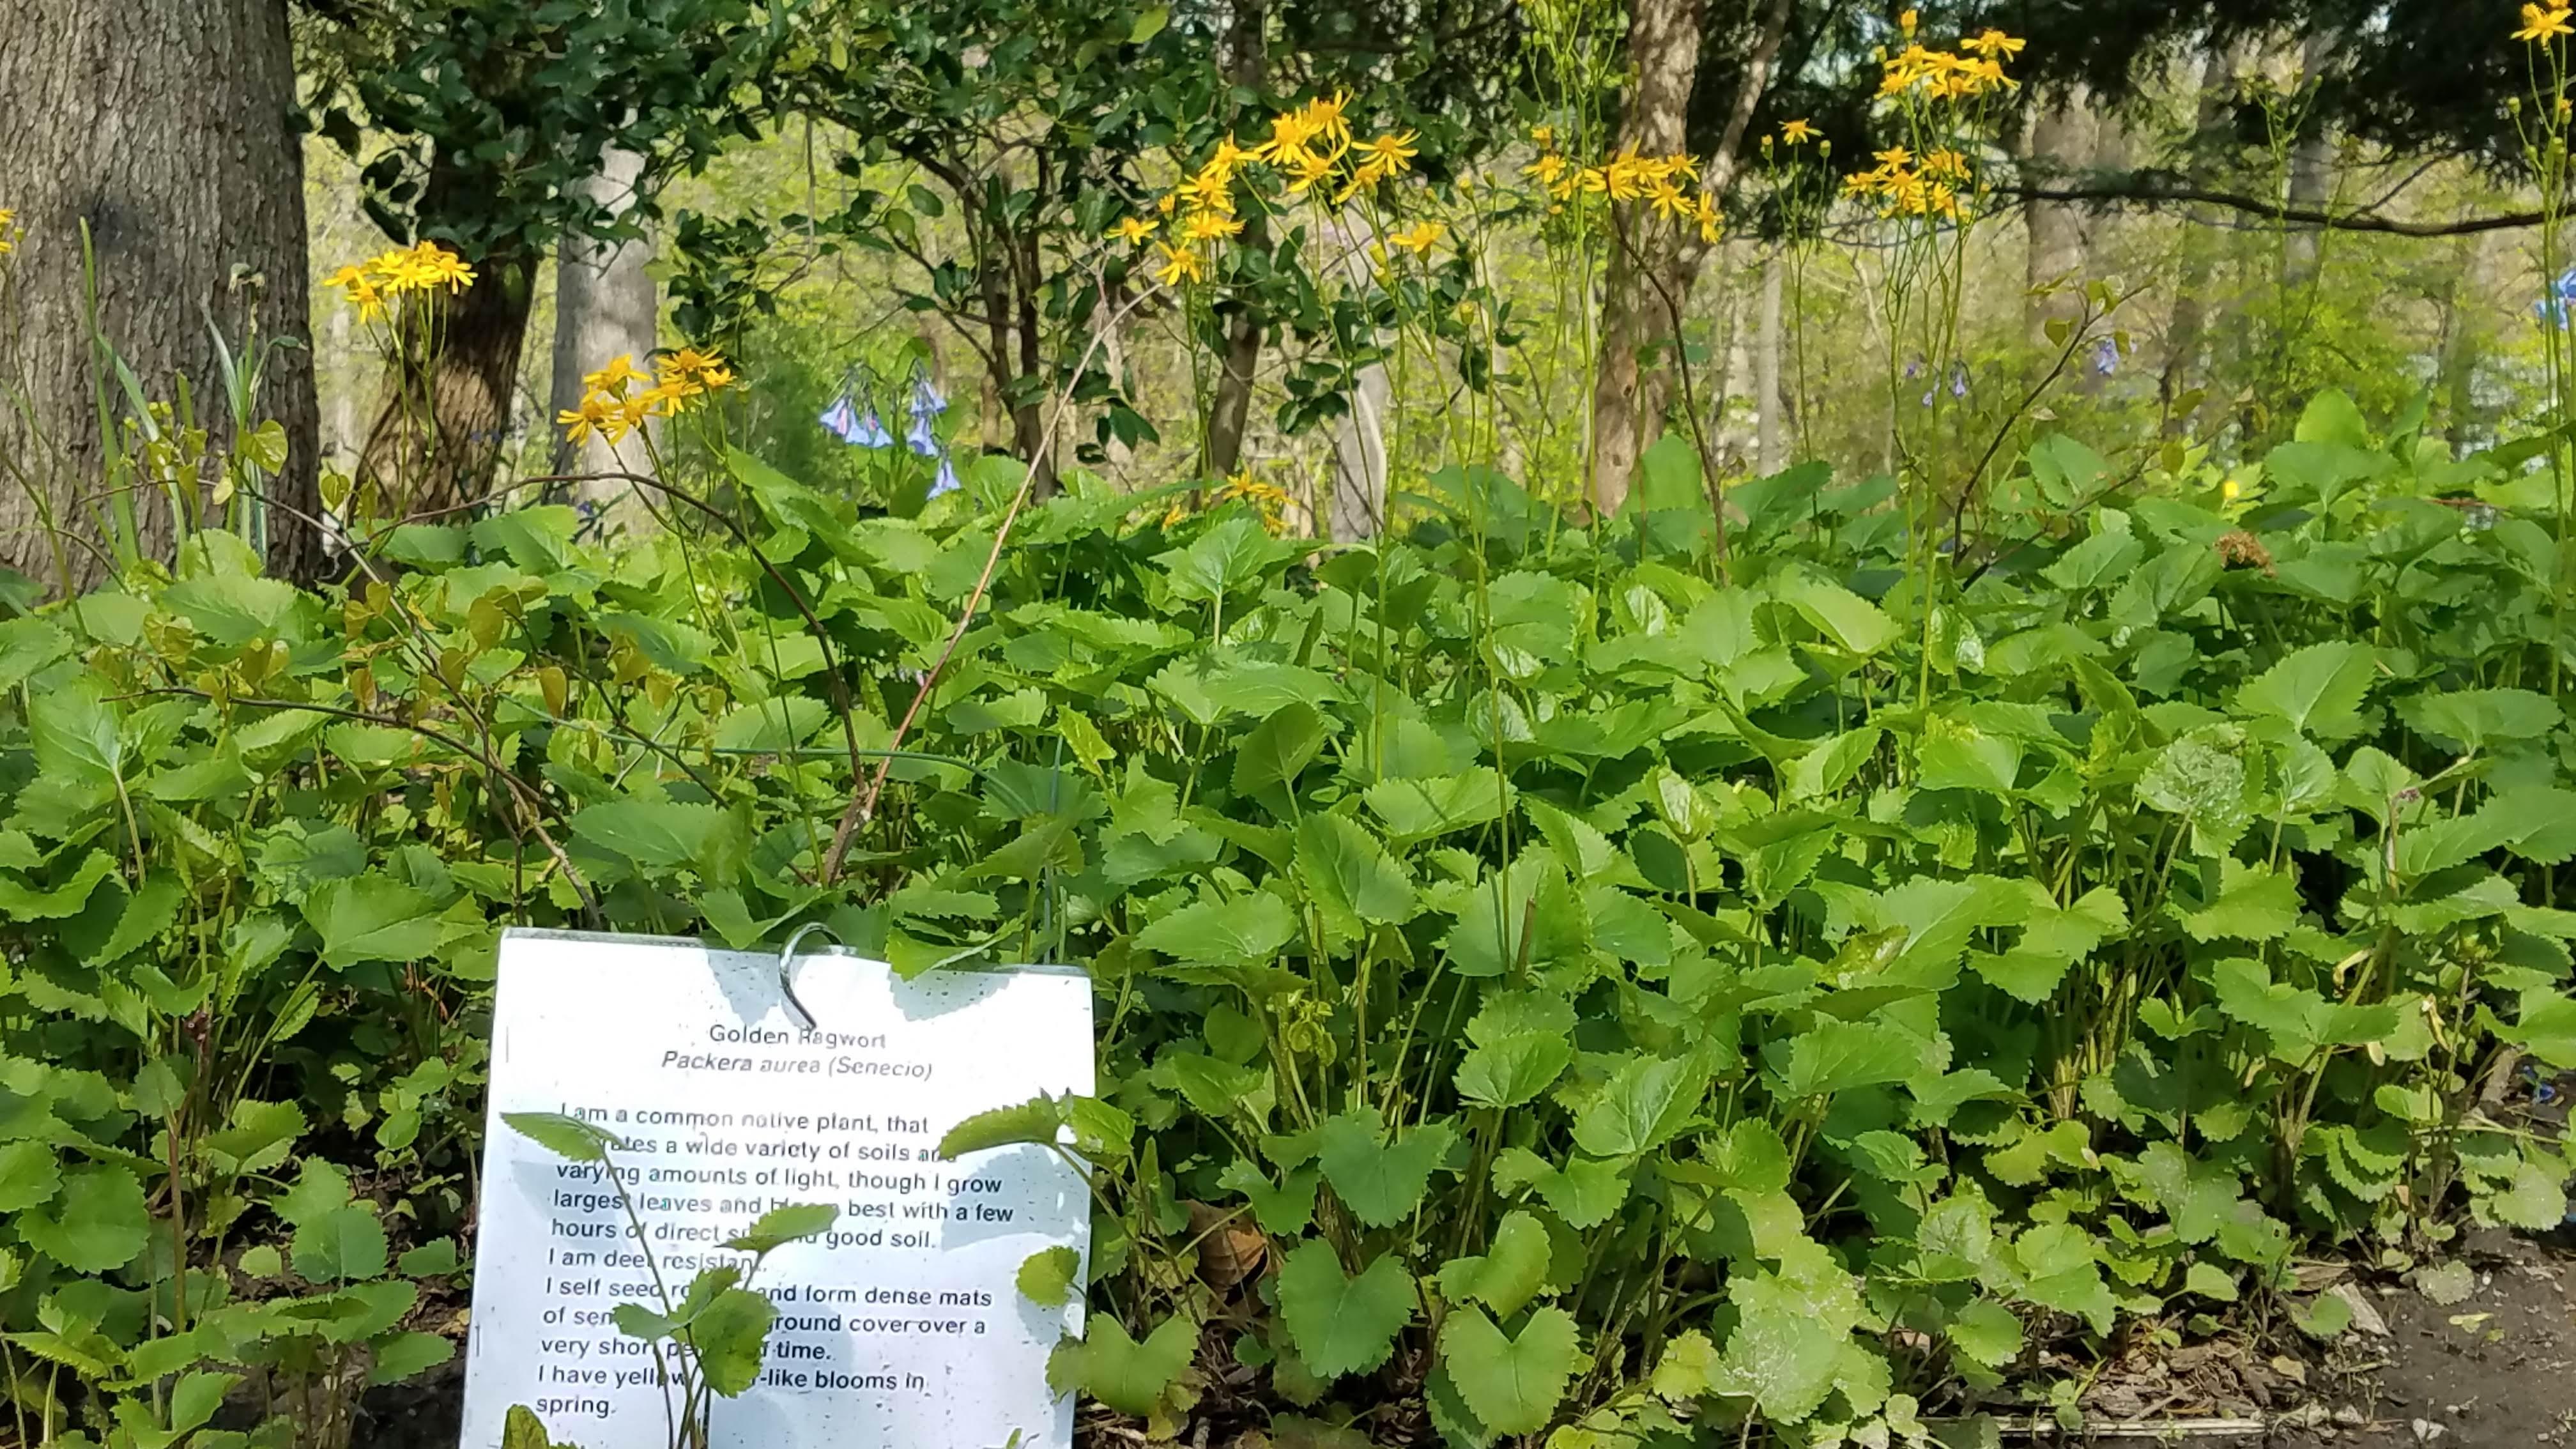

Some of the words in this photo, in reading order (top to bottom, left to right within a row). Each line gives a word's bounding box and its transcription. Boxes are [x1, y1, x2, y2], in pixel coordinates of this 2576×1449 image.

[710, 1023, 789, 1045] Golden
[799, 1027, 886, 1049] Ragwort
[661, 1050, 753, 1071] Packera
[760, 1059, 821, 1073] aurea
[828, 1056, 933, 1081] (Senecio)
[562, 1102, 566, 1116] I
[574, 1107, 608, 1122] am
[616, 1109, 628, 1123] a
[636, 1110, 733, 1128] common
[741, 1112, 809, 1130] native
[817, 1112, 878, 1133] plant,
[887, 1116, 929, 1133] that
[666, 1140, 677, 1153] a
[686, 1135, 737, 1155] wide
[746, 1142, 821, 1162] variety
[829, 1142, 850, 1159] of
[859, 1144, 910, 1161] soils
[556, 1165, 640, 1185] varying
[649, 1168, 747, 1184] amounts
[756, 1167, 778, 1185] of
[785, 1169, 840, 1191] light,
[848, 1170, 926, 1194] though
[935, 1173, 939, 1191] I
[947, 1179, 1002, 1197] grow
[640, 1193, 712, 1211] leaves
[720, 1197, 761, 1214] and
[848, 1199, 894, 1218] best
[902, 1202, 949, 1220] with
[956, 1207, 968, 1221] a
[976, 1203, 1014, 1222] few
[552, 1218, 617, 1238] hours
[625, 1222, 647, 1239] of
[655, 1222, 719, 1241] direct
[826, 1229, 882, 1250] good
[891, 1230, 936, 1249] soil.
[549, 1248, 554, 1265] I
[562, 1252, 595, 1266] am
[546, 1277, 551, 1294] I
[560, 1278, 601, 1295] self
[806, 1284, 857, 1303] form
[864, 1286, 932, 1305] dense
[939, 1289, 992, 1307] mats
[543, 1306, 565, 1323] of
[849, 1317, 910, 1333] cover
[917, 1319, 968, 1334] over
[974, 1320, 986, 1334] a
[541, 1340, 590, 1359] very
[599, 1337, 650, 1355] shor
[777, 1340, 832, 1360] time.
[539, 1365, 544, 1382] I
[552, 1366, 608, 1384] have
[615, 1367, 685, 1389] yellw
[815, 1370, 898, 1390] blooms
[535, 1395, 617, 1418] spring.
